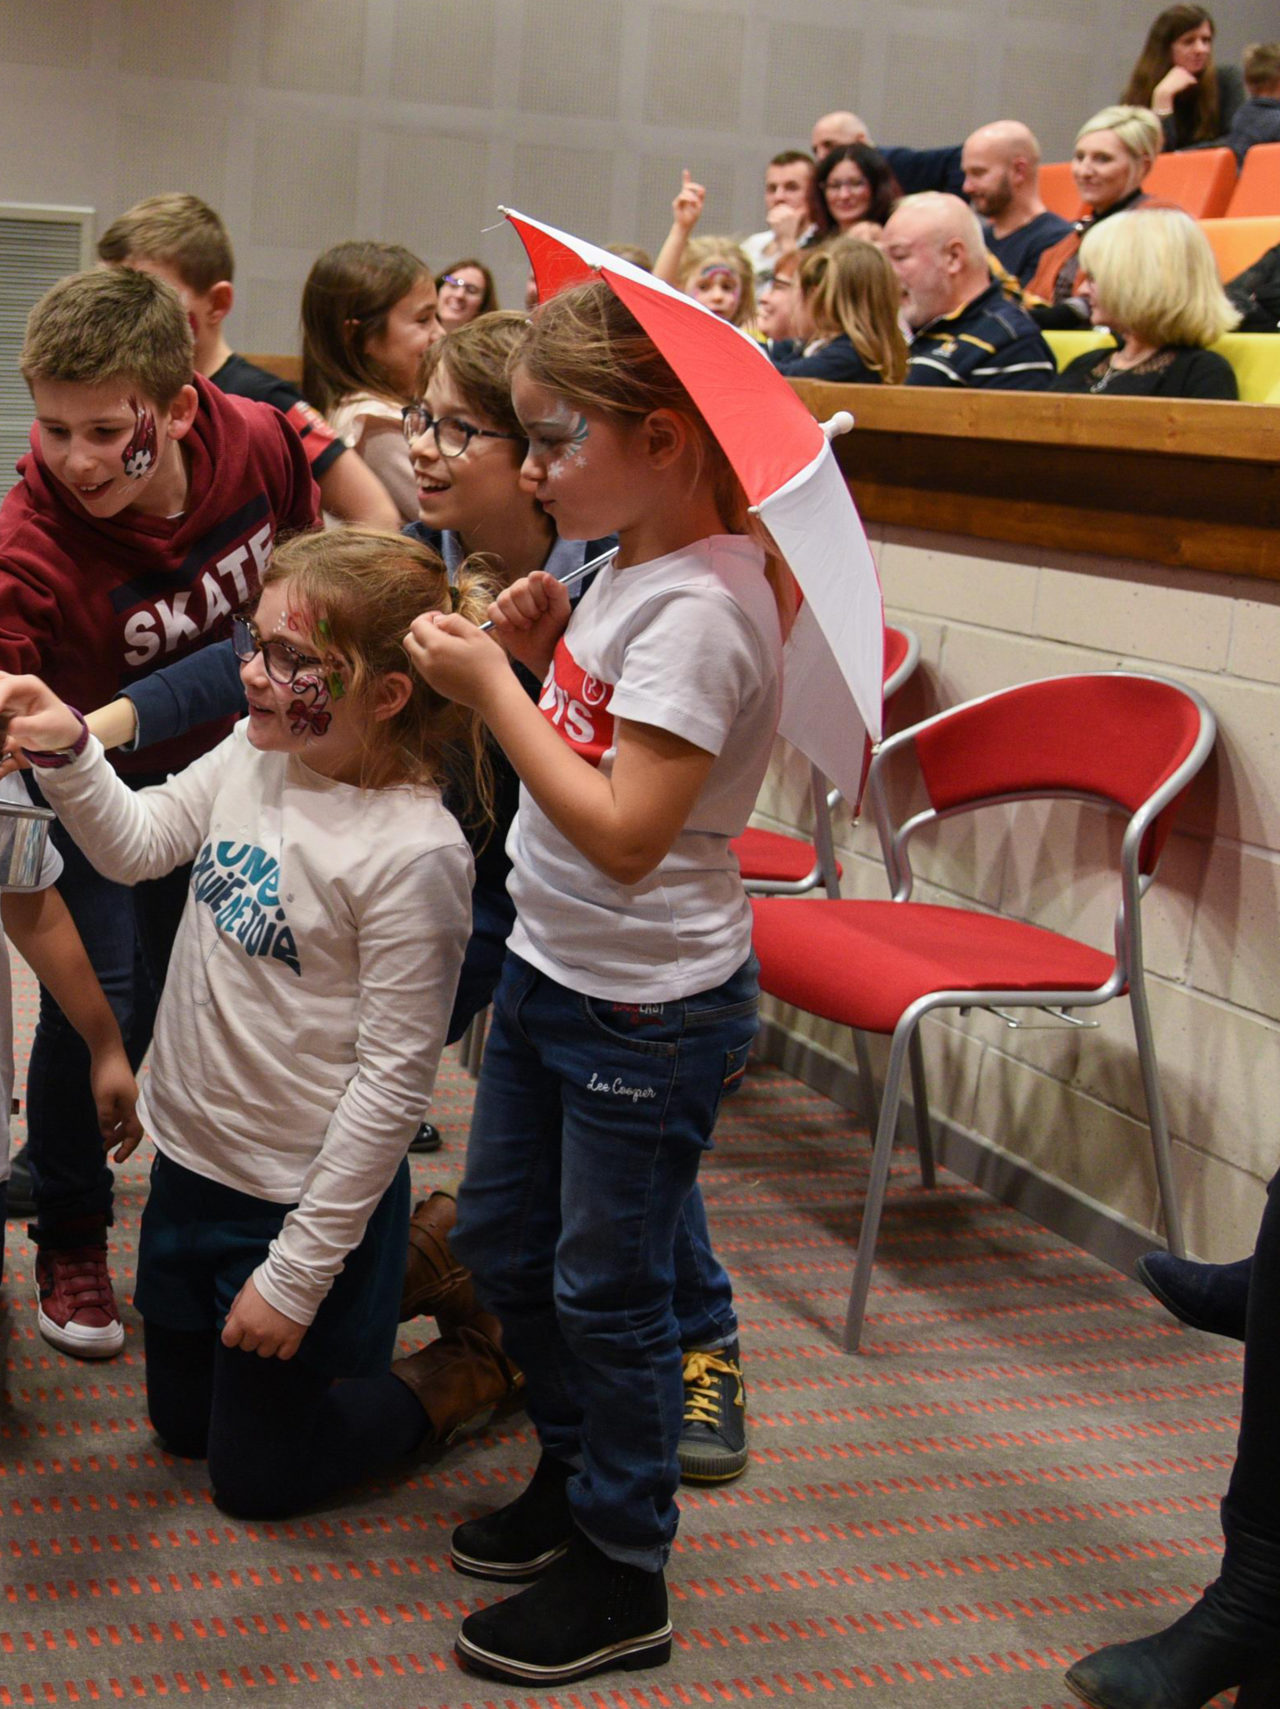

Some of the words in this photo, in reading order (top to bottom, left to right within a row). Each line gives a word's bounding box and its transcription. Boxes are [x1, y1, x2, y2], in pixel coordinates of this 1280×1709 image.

[124, 523, 272, 667] SKATE
[586, 1072, 611, 1092] Lee
[612, 1077, 657, 1103] Cooper
